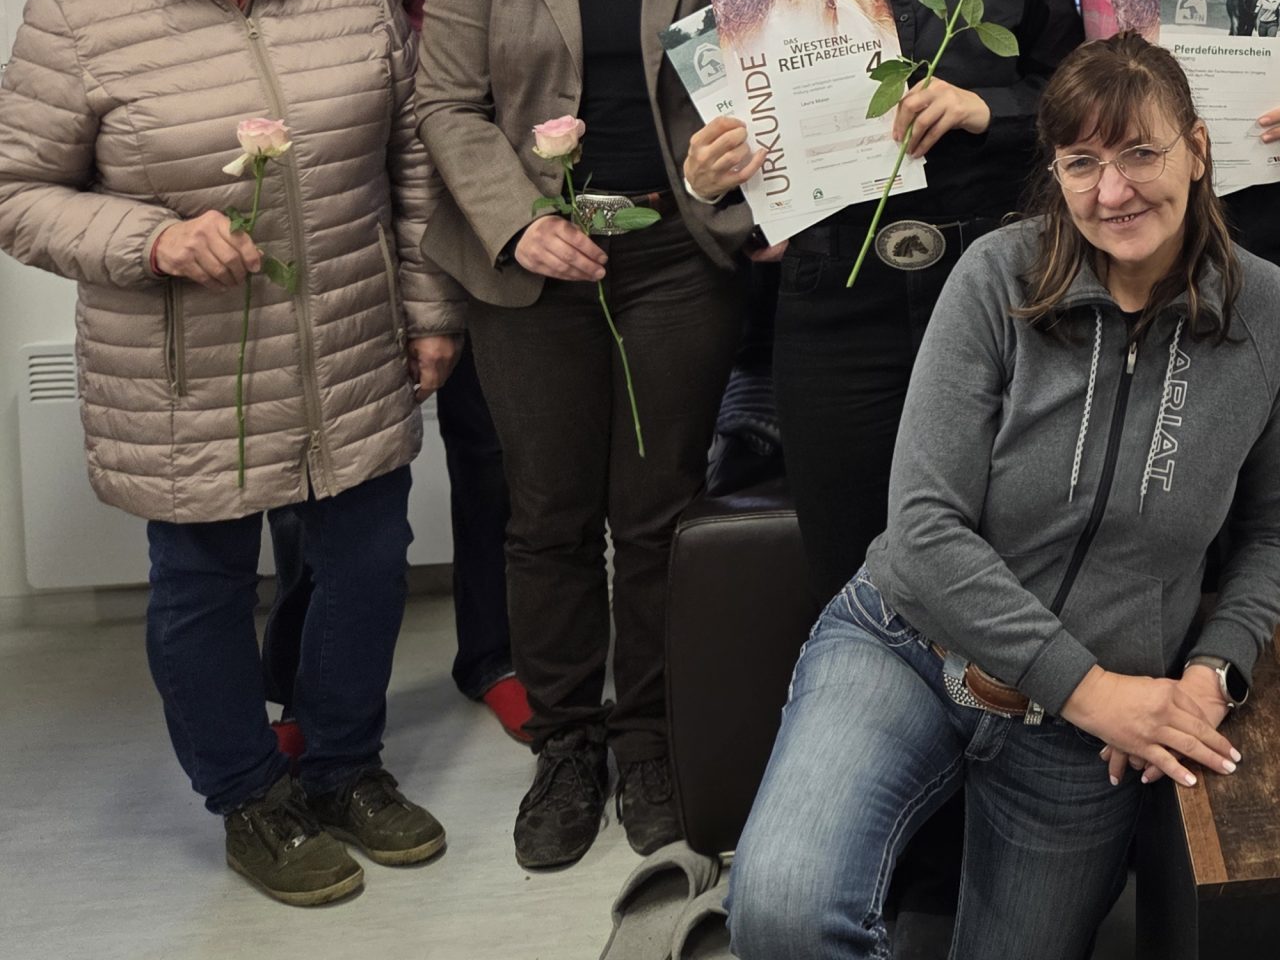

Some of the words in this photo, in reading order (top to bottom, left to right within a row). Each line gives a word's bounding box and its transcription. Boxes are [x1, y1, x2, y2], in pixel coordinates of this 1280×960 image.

[783, 37, 799, 46] DAS
[790, 34, 853, 55] WESTERN-
[1174, 44, 1272, 57] Pferdeführerschein
[778, 39, 882, 72] REITABZEICHEN
[740, 52, 791, 197] URKUNDE
[1149, 347, 1191, 492] ARIAT
